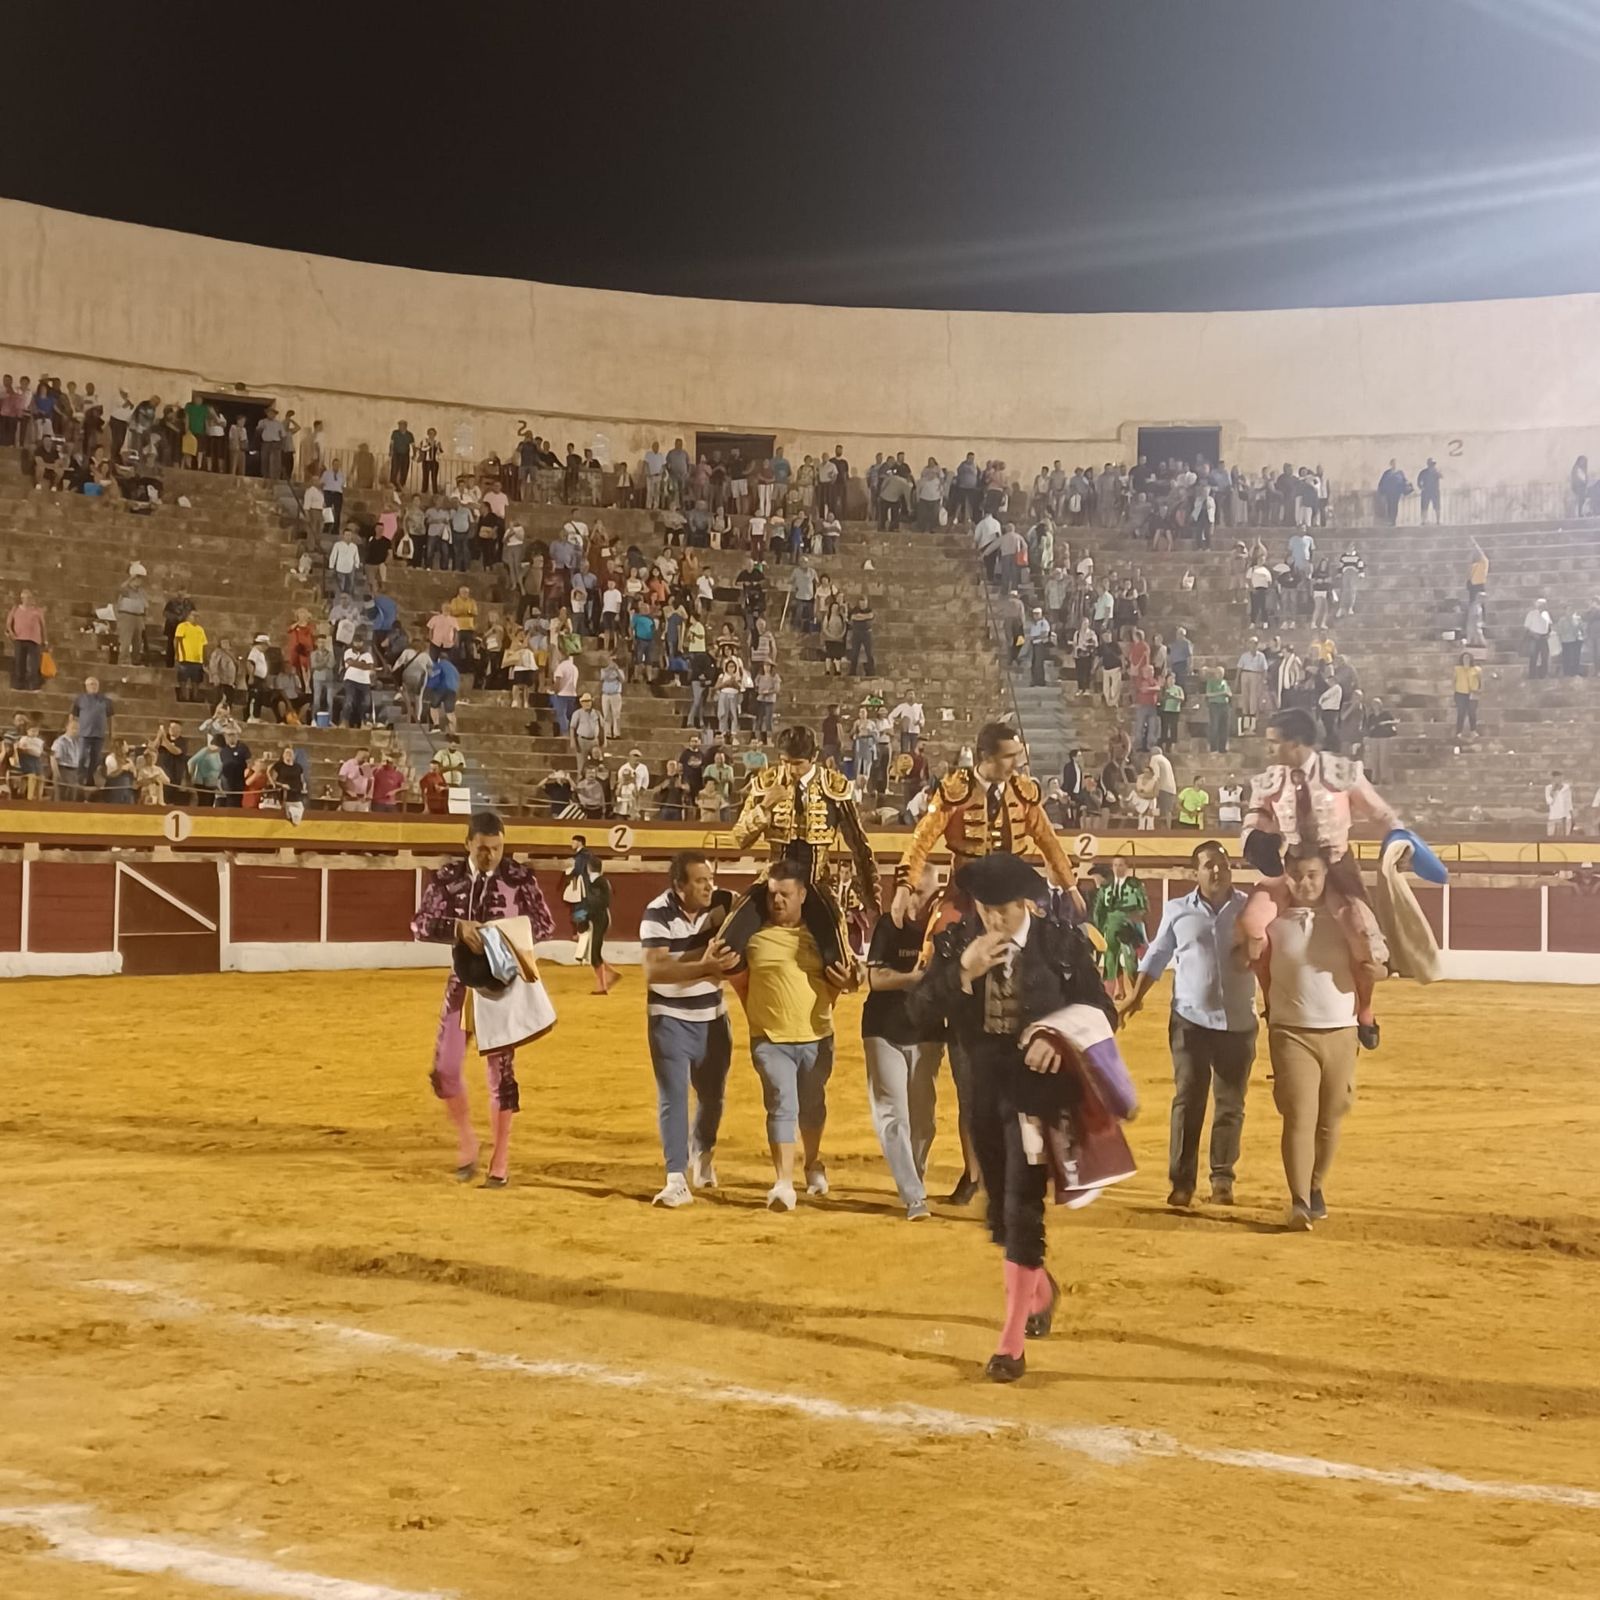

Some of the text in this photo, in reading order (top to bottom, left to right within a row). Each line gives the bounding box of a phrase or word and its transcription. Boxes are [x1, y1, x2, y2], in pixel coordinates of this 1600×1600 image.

[1448, 439, 1464, 457] 2
[171, 814, 180, 839] 1
[614, 827, 628, 849] 2
[1079, 836, 1093, 856] 2
